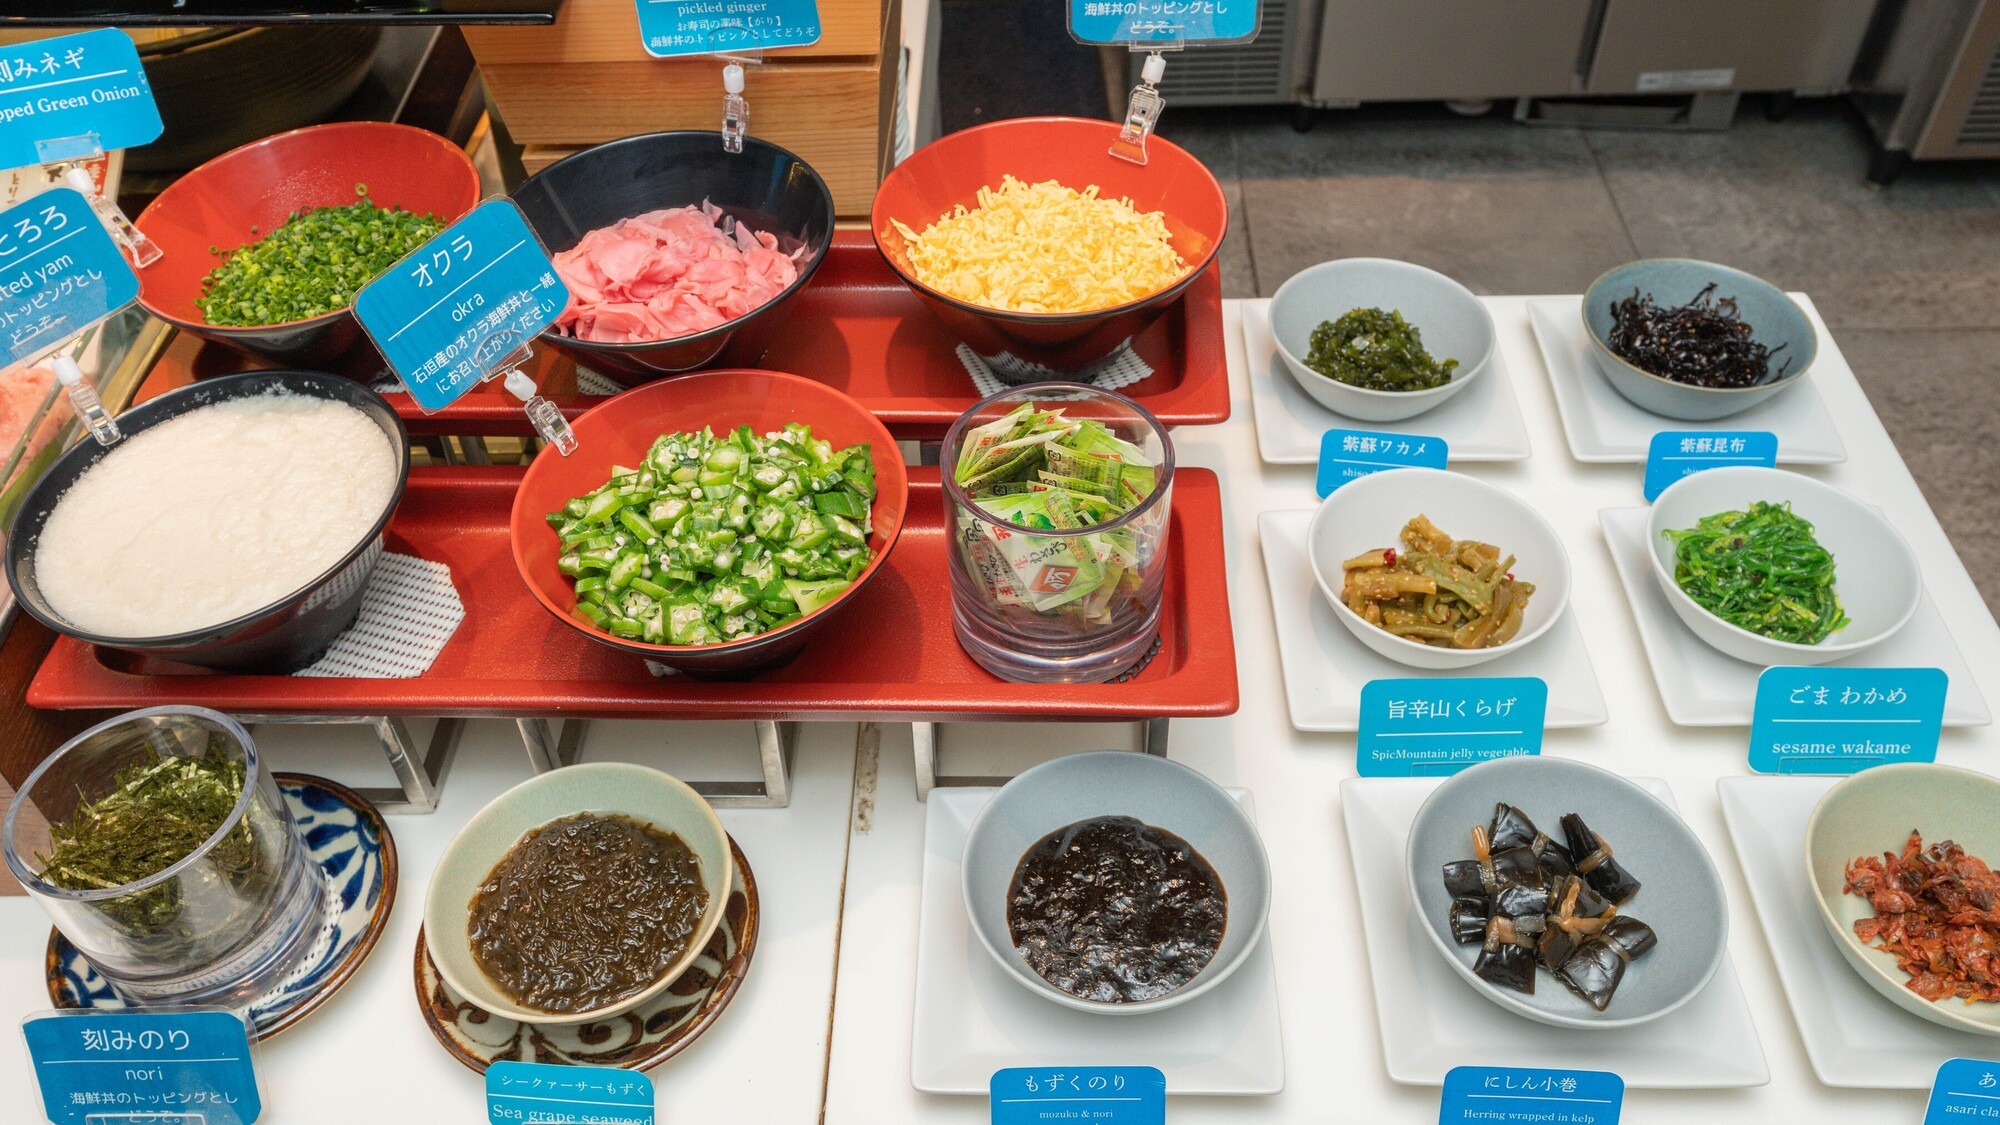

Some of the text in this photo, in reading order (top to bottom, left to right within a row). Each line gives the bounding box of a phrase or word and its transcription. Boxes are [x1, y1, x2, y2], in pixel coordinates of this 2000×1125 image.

[677, 1, 767, 16] pickled ginger
[1084, 1, 1228, 17] 海鮮丼のトッピングとし
[37, 95, 89, 113] Green
[91, 85, 140, 103] Onion
[410, 234, 473, 288] オクラ
[0, 254, 73, 300] ted yam
[451, 292, 486, 322] okra
[411, 271, 556, 384] 石垣産のオクラ海鮮丼と一緒
[436, 299, 556, 394] にお召し上がりください
[1342, 435, 1426, 456] 紫蘇ワカメ
[1680, 437, 1746, 453] 紫蘇昆布
[1789, 685, 1907, 705] ごま わかめ
[1388, 697, 1517, 720] 旨辛山くらげ
[1372, 747, 1530, 761] SpicMountain jelly vegetable
[1772, 740, 1911, 754] sesame wakame
[80, 1028, 190, 1052] 刻みのり
[125, 1066, 163, 1081] nori
[1978, 1072, 1997, 1088] あ
[501, 1075, 645, 1096] シークァーサーもずく
[1025, 1074, 1125, 1092] もずくのり
[1485, 1076, 1577, 1093] にしん小巻
[69, 1091, 238, 1105] 海鮮丼のトッピングとし
[493, 1104, 523, 1119] Sea
[1039, 1109, 1113, 1119] mozuku & nori
[1464, 1109, 1594, 1125] Herring wrapped in kelp
[1945, 1105, 2000, 1118] asari cla
